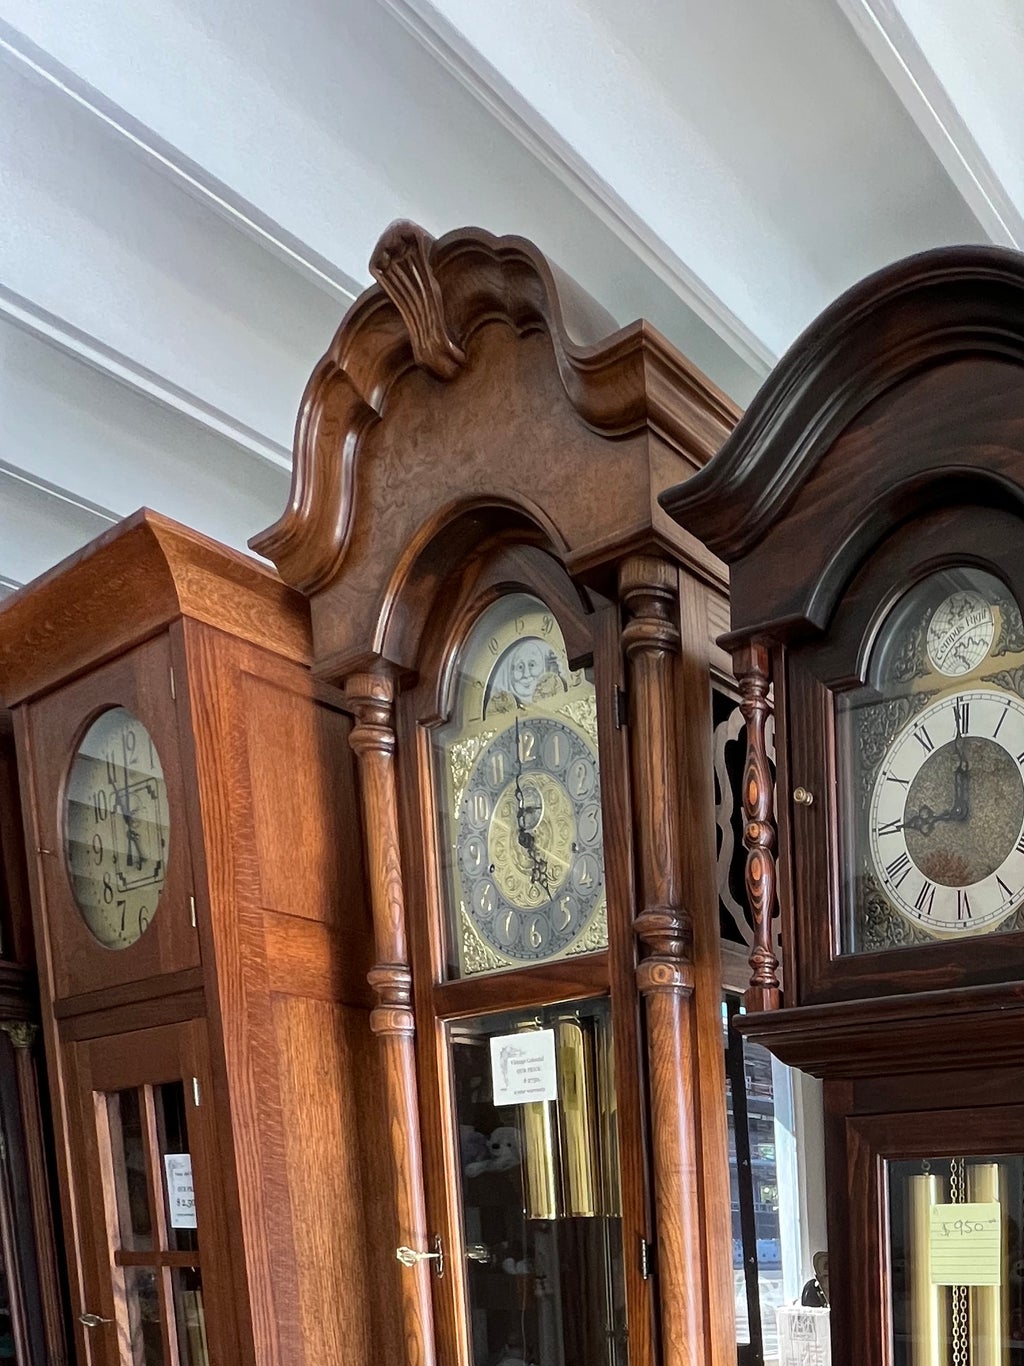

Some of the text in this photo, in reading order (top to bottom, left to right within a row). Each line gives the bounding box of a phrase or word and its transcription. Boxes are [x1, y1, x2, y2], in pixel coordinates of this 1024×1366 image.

[553, 735, 560, 767] 1
[913, 725, 936, 758] XI
[491, 754, 504, 785] 11
[576, 763, 588, 796] 2
[587, 811, 598, 842] 3
[92, 834, 104, 866] 9
[103, 872, 115, 904] 8
[579, 861, 593, 889] 4
[117, 900, 127, 931] 7
[560, 896, 571, 932] 5
[957, 889, 973, 920] VI
[139, 905, 149, 936] 6
[531, 918, 542, 948] 6
